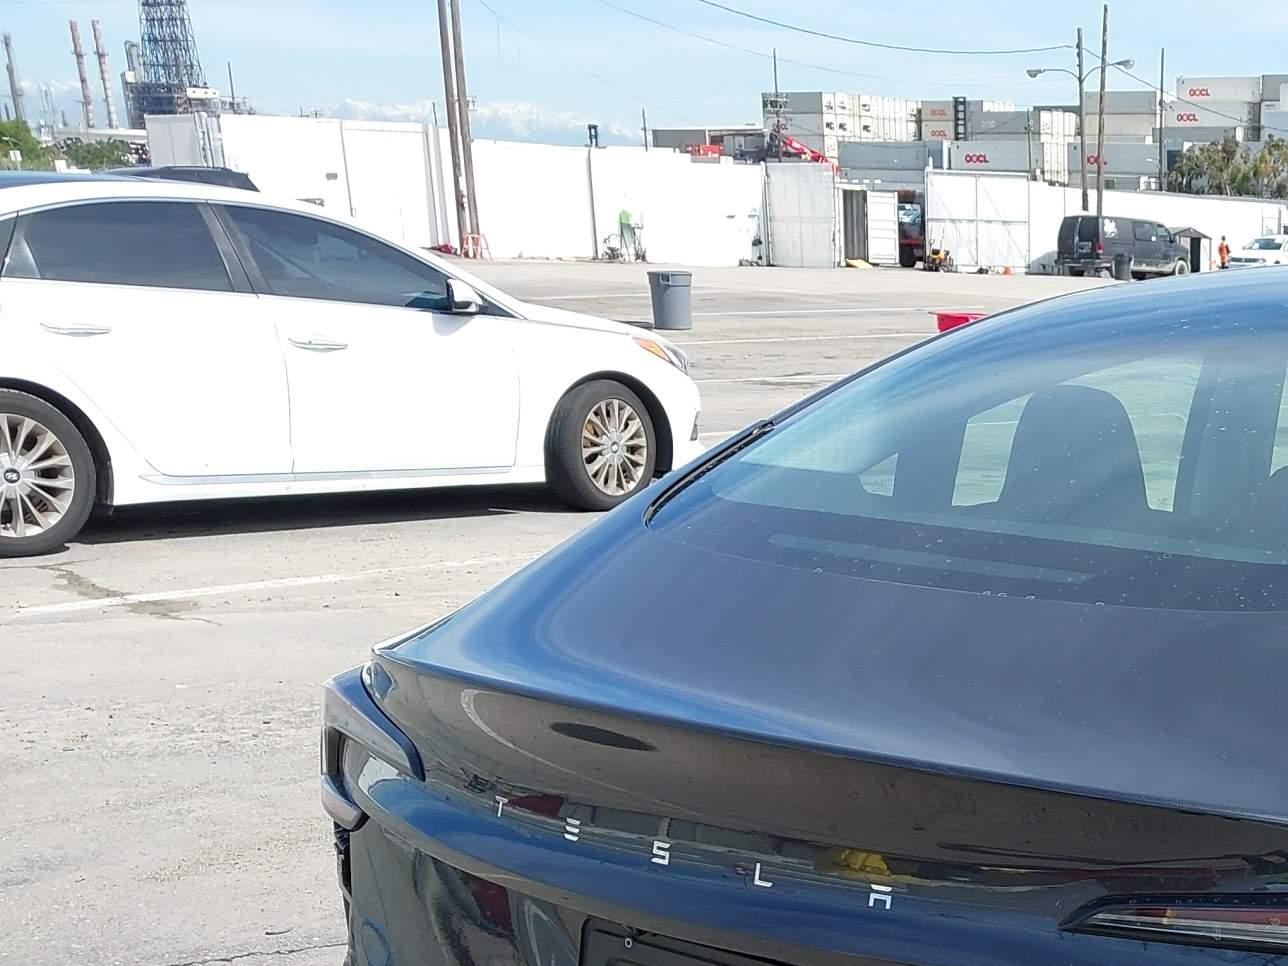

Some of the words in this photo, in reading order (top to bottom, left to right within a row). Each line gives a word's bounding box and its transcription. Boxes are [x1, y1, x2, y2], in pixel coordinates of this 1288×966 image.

[1188, 88, 1211, 97] OOCL
[1176, 113, 1199, 122] OOCL
[964, 153, 990, 164] OOCL
[495, 795, 892, 910] TESLA
